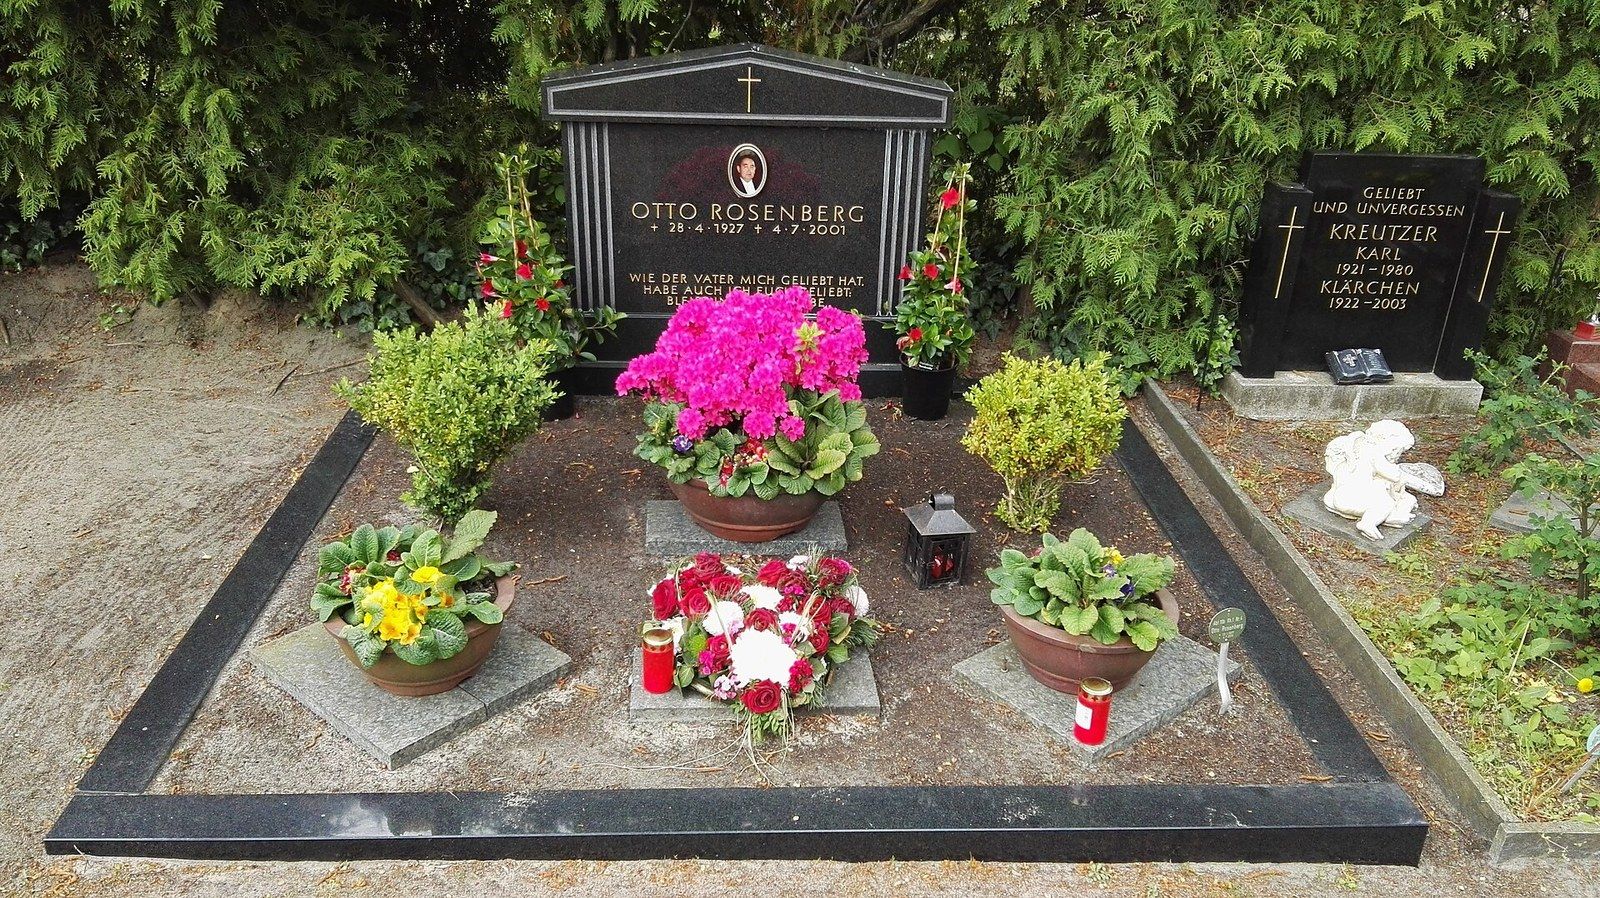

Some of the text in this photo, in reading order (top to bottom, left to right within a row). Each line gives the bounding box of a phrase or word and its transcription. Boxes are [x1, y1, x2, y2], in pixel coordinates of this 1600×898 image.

[1363, 186, 1425, 200] GELIEBT
[631, 202, 864, 223] OTTO ROSENBERG
[1313, 201, 1465, 217] UND UNVERGESSEN
[1329, 223, 1438, 242] KREUTZER
[1355, 246, 1401, 261] KARL
[629, 273, 656, 283] WIE
[661, 273, 688, 284] DER
[693, 274, 735, 285] VATER
[740, 275, 775, 285] MICH
[781, 275, 834, 286] GELIEBT
[1320, 279, 1420, 295] KLÄRCHEN
[643, 285, 679, 295] HABE
[683, 286, 722, 296] AUCH
[728, 286, 751, 296] IH
[802, 286, 852, 298] ELIEBT:
